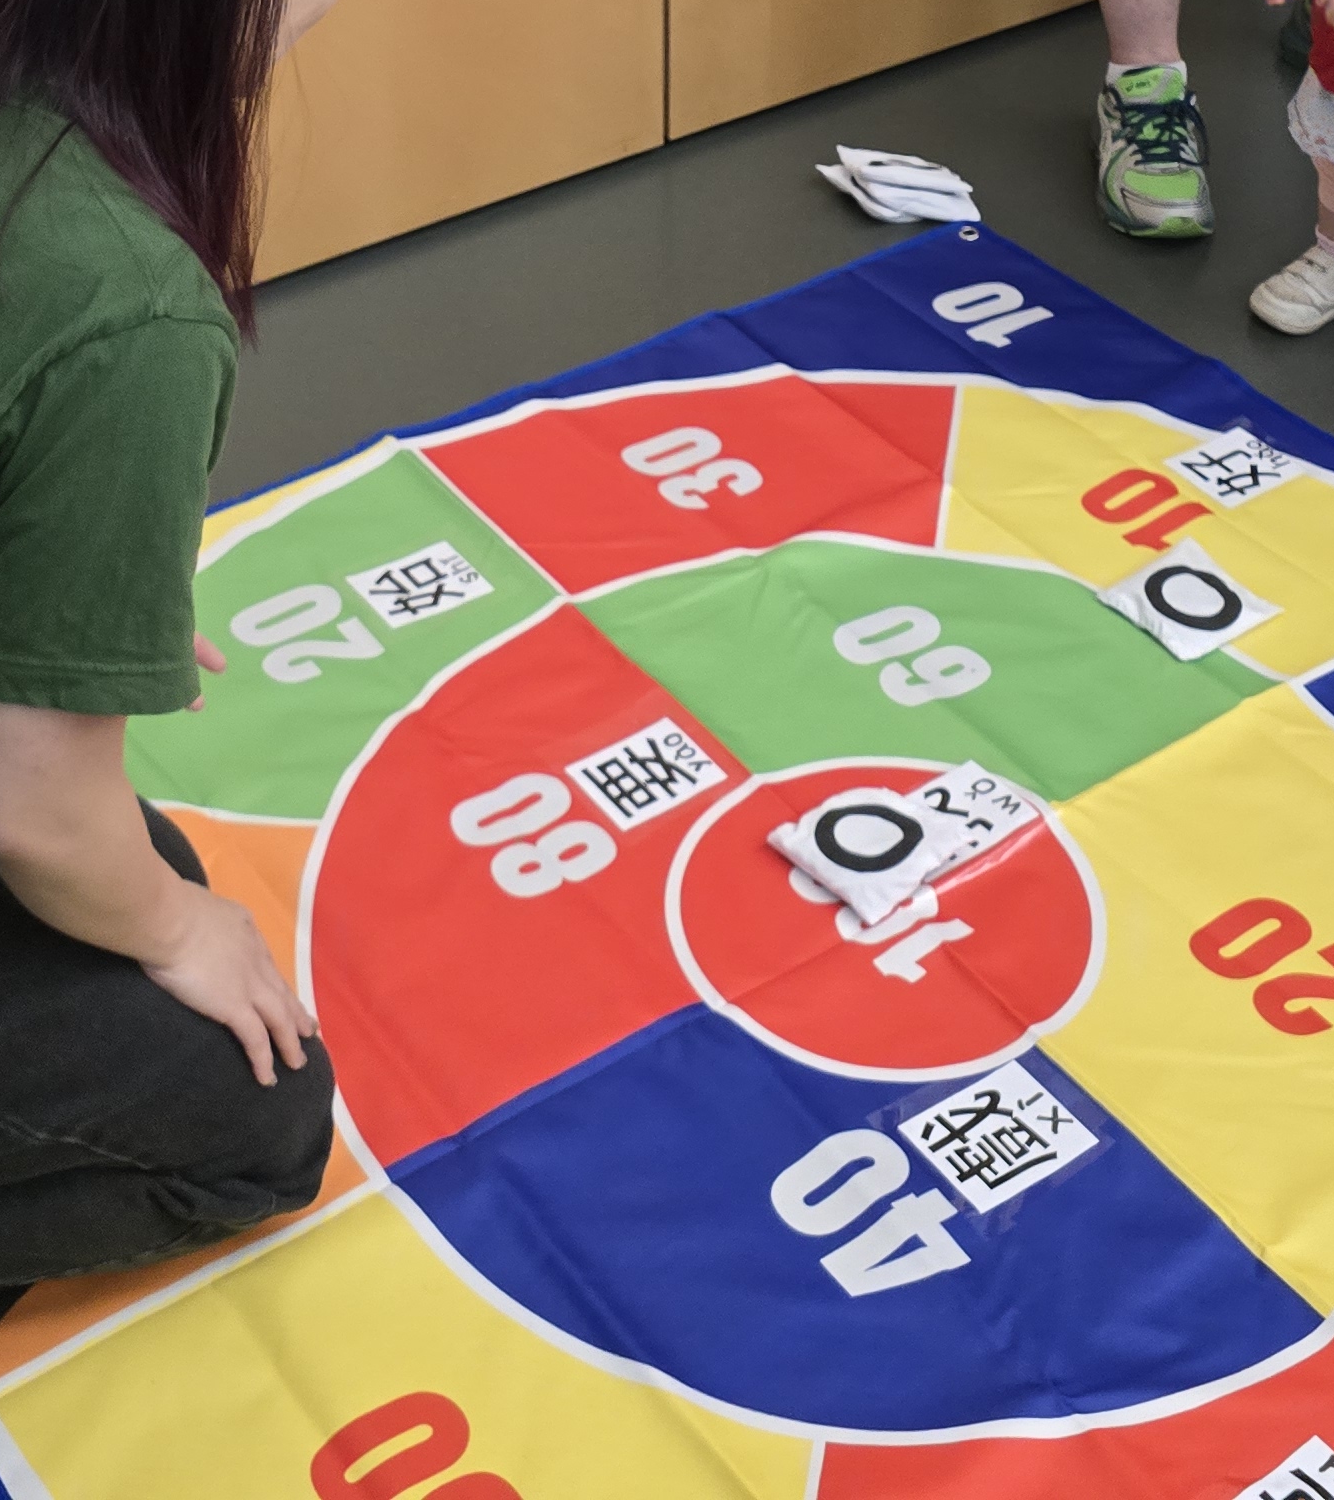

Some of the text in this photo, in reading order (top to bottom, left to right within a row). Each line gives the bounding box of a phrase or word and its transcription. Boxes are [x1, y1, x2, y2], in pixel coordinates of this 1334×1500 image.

[932, 281, 1054, 348] 10
[620, 426, 764, 510] 30
[1080, 468, 1218, 552] 10
[1180, 449, 1282, 497] 好
[369, 557, 466, 616] 始
[229, 583, 386, 684] 20
[833, 605, 992, 706] 60
[581, 737, 699, 818] 要
[449, 772, 617, 898] 80
[921, 1088, 1058, 1189] 戲
[770, 1128, 971, 1298] 40
